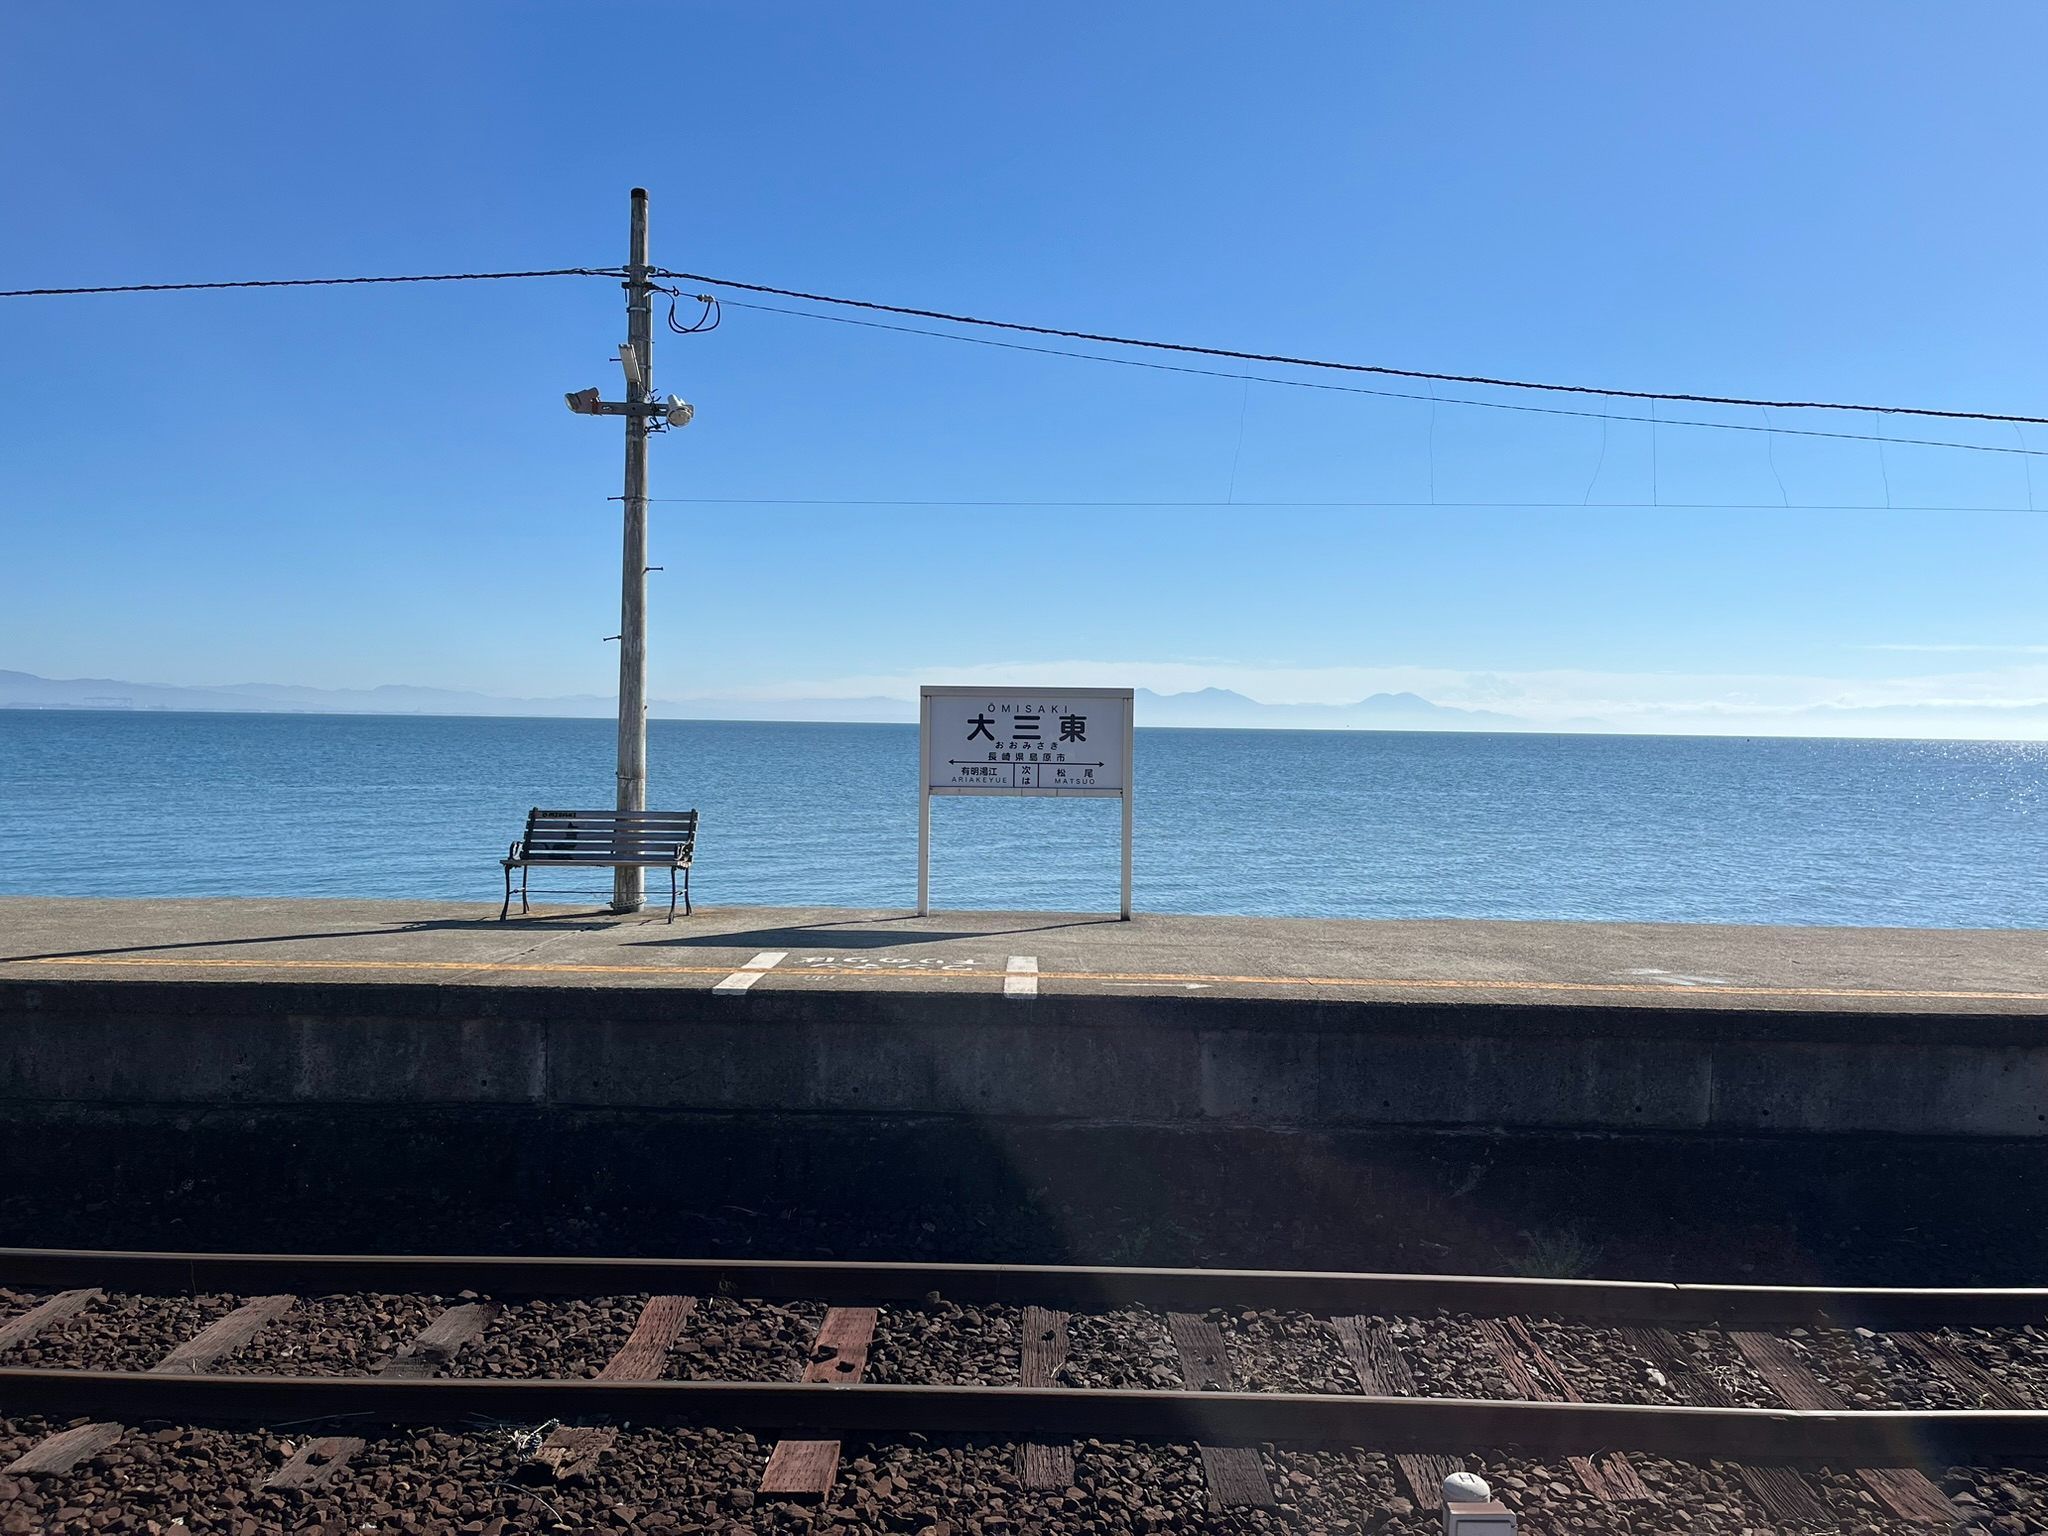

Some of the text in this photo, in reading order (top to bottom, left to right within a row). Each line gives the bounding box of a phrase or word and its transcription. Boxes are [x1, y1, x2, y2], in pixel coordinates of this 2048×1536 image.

[967, 713, 1087, 742] 大三東
[995, 742, 1058, 750] おおみさき
[988, 752, 1066, 762] 長崎県島原市
[961, 767, 997, 776] 有明湯江
